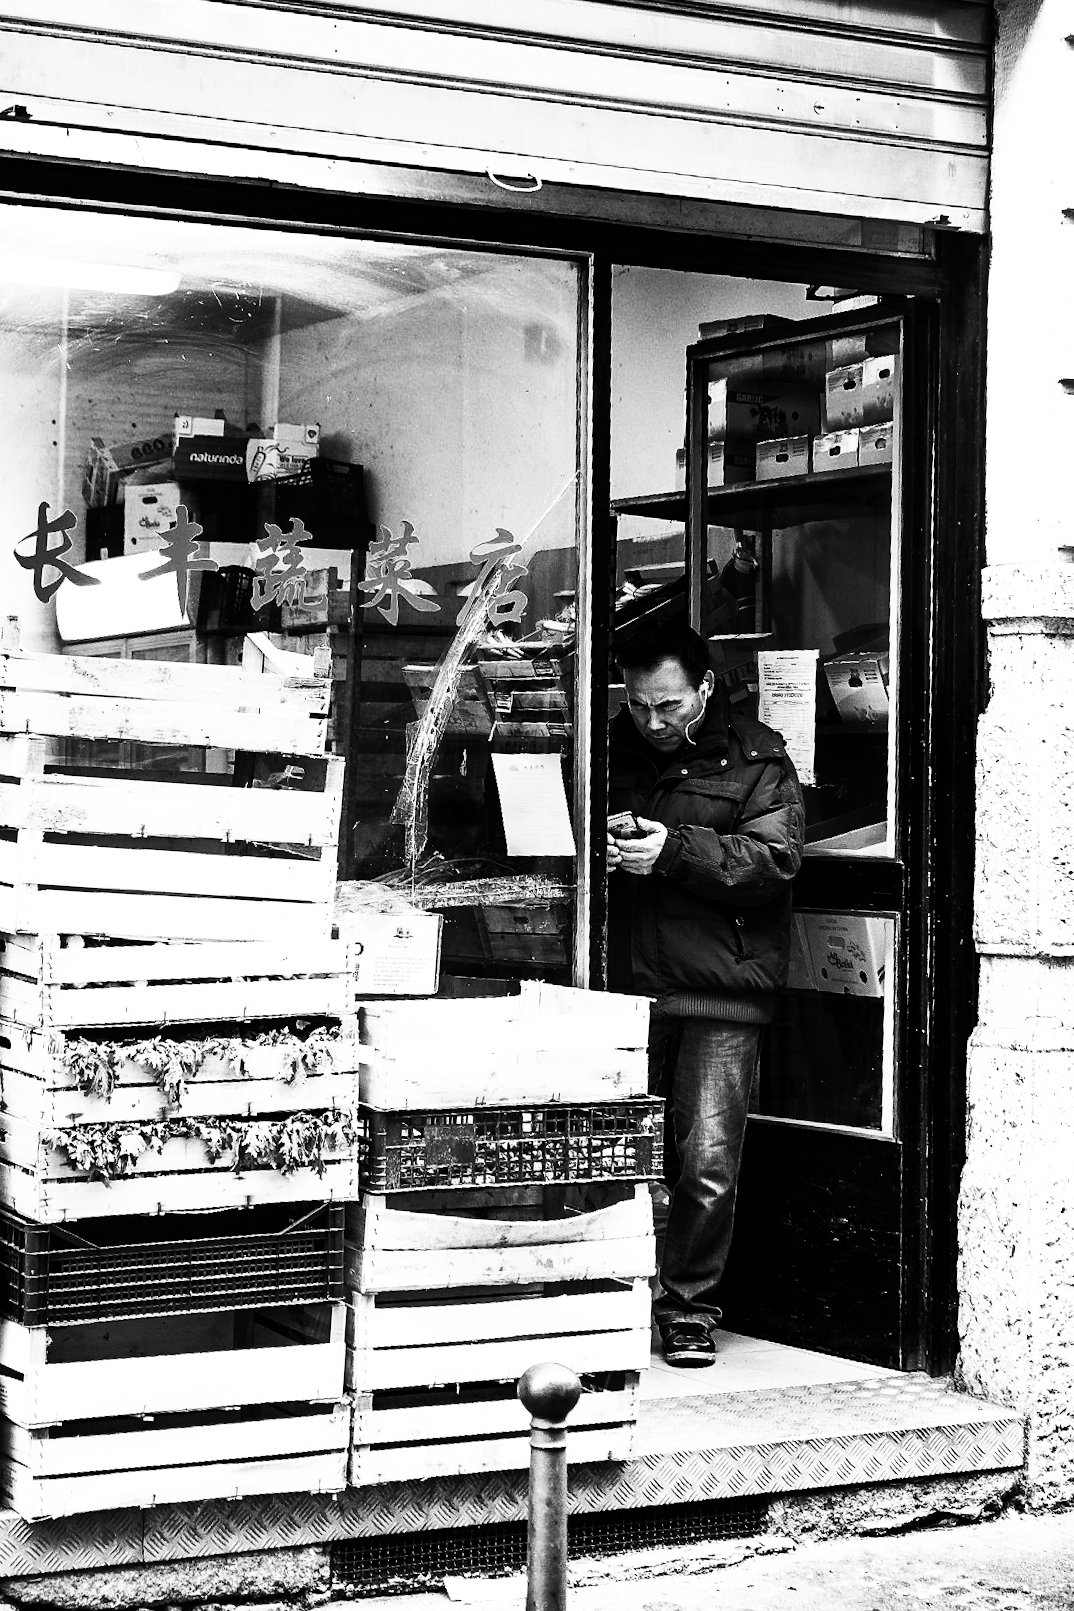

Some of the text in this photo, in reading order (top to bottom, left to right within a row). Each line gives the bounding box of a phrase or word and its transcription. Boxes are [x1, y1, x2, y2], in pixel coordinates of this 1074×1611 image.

[736, 392, 763, 403] GARLIC
[189, 452, 244, 465] naturinda
[13, 501, 531, 628] 长丰蔬菜店
